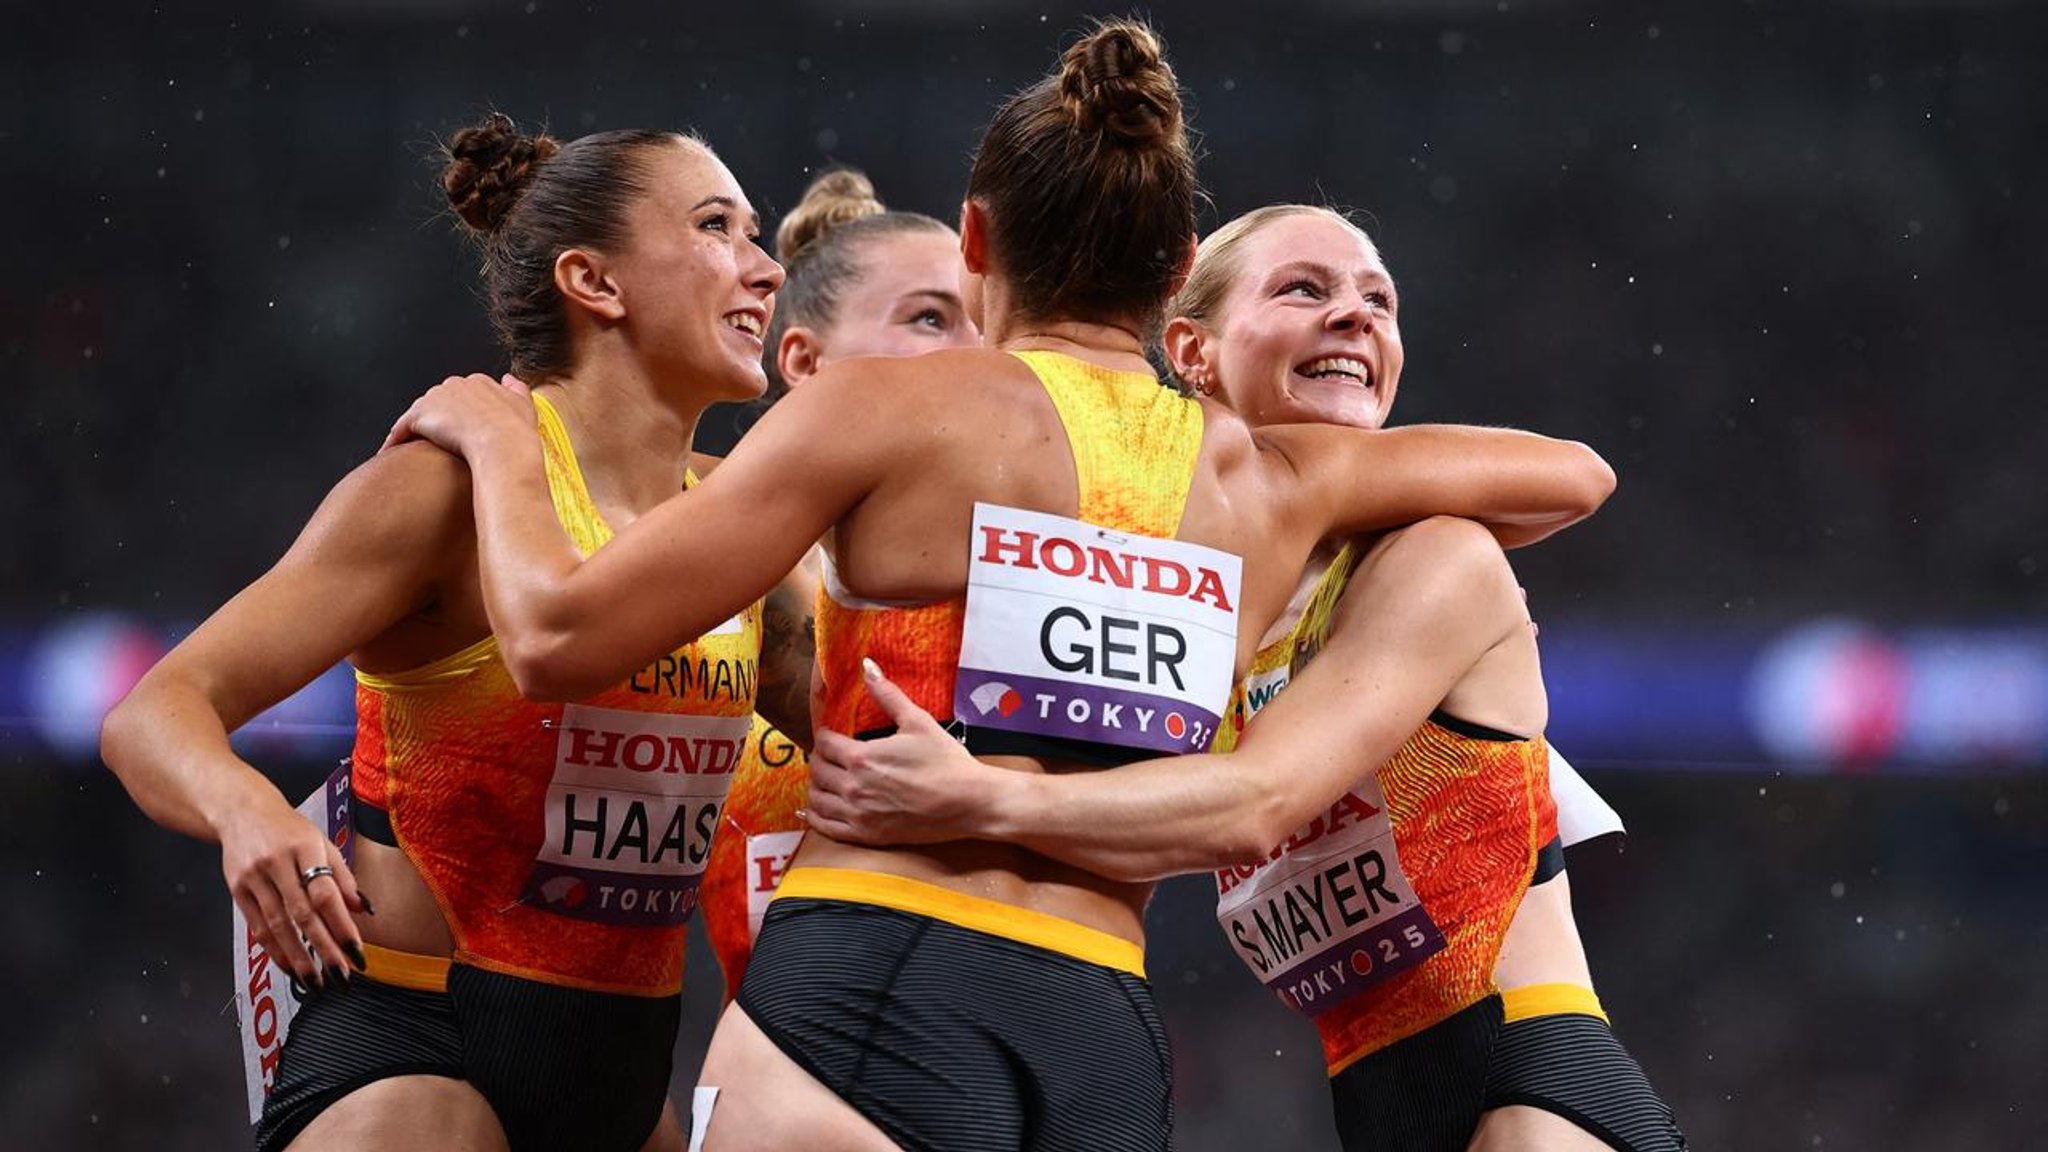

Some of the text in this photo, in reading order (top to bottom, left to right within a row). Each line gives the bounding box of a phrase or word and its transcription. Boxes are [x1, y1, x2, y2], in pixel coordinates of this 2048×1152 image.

[978, 525, 1234, 614] HONDA
[1039, 606, 1188, 692] GER
[561, 793, 725, 864] HAAS
[1231, 849, 1400, 974] S.MAYER
